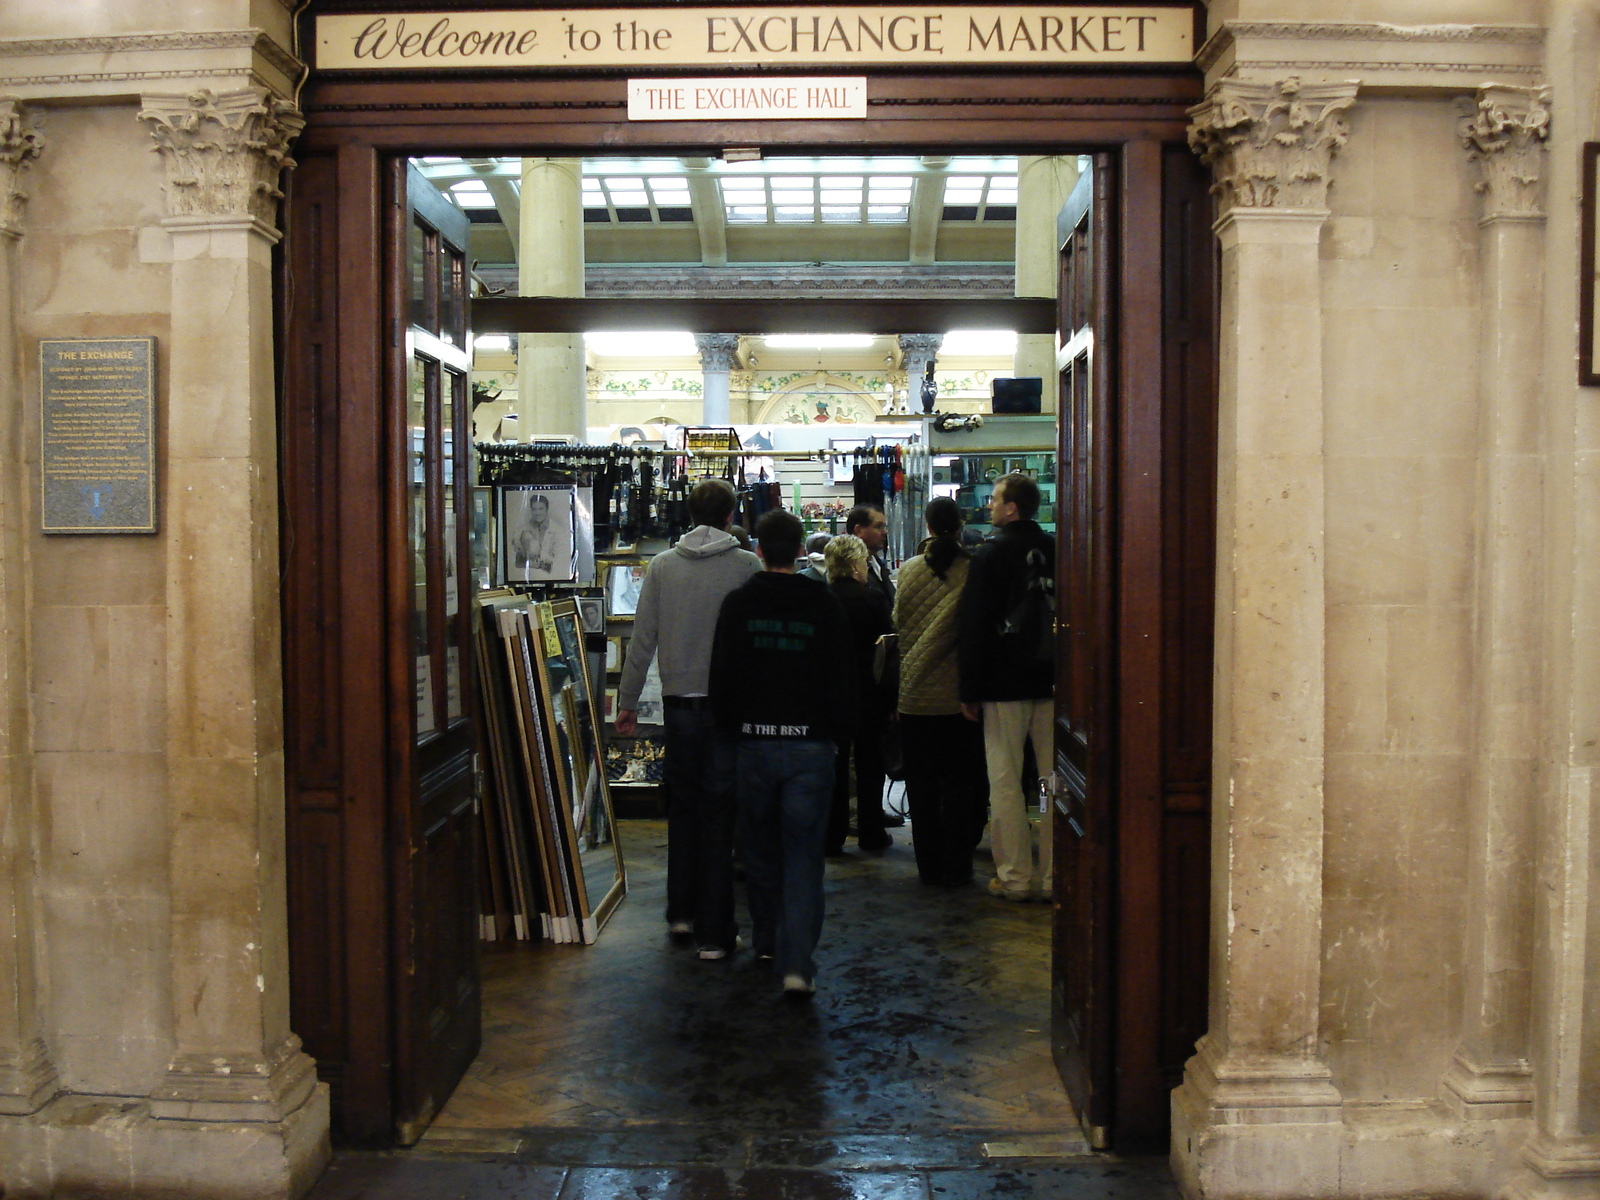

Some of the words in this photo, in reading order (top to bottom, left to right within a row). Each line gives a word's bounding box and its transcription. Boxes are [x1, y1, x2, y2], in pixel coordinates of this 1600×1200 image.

[351, 17, 539, 60] Welcome
[565, 22, 601, 51] to
[612, 20, 673, 51] the
[706, 14, 944, 54] EXCHANGE
[967, 15, 1158, 53] MARKET
[646, 88, 687, 110] THE
[695, 86, 798, 109] EXCHANGE
[806, 86, 853, 109] HALL
[58, 352, 77, 360] THE
[80, 351, 134, 360] EXCHANGE
[755, 724, 777, 736] THE
[780, 725, 809, 736] BEST
